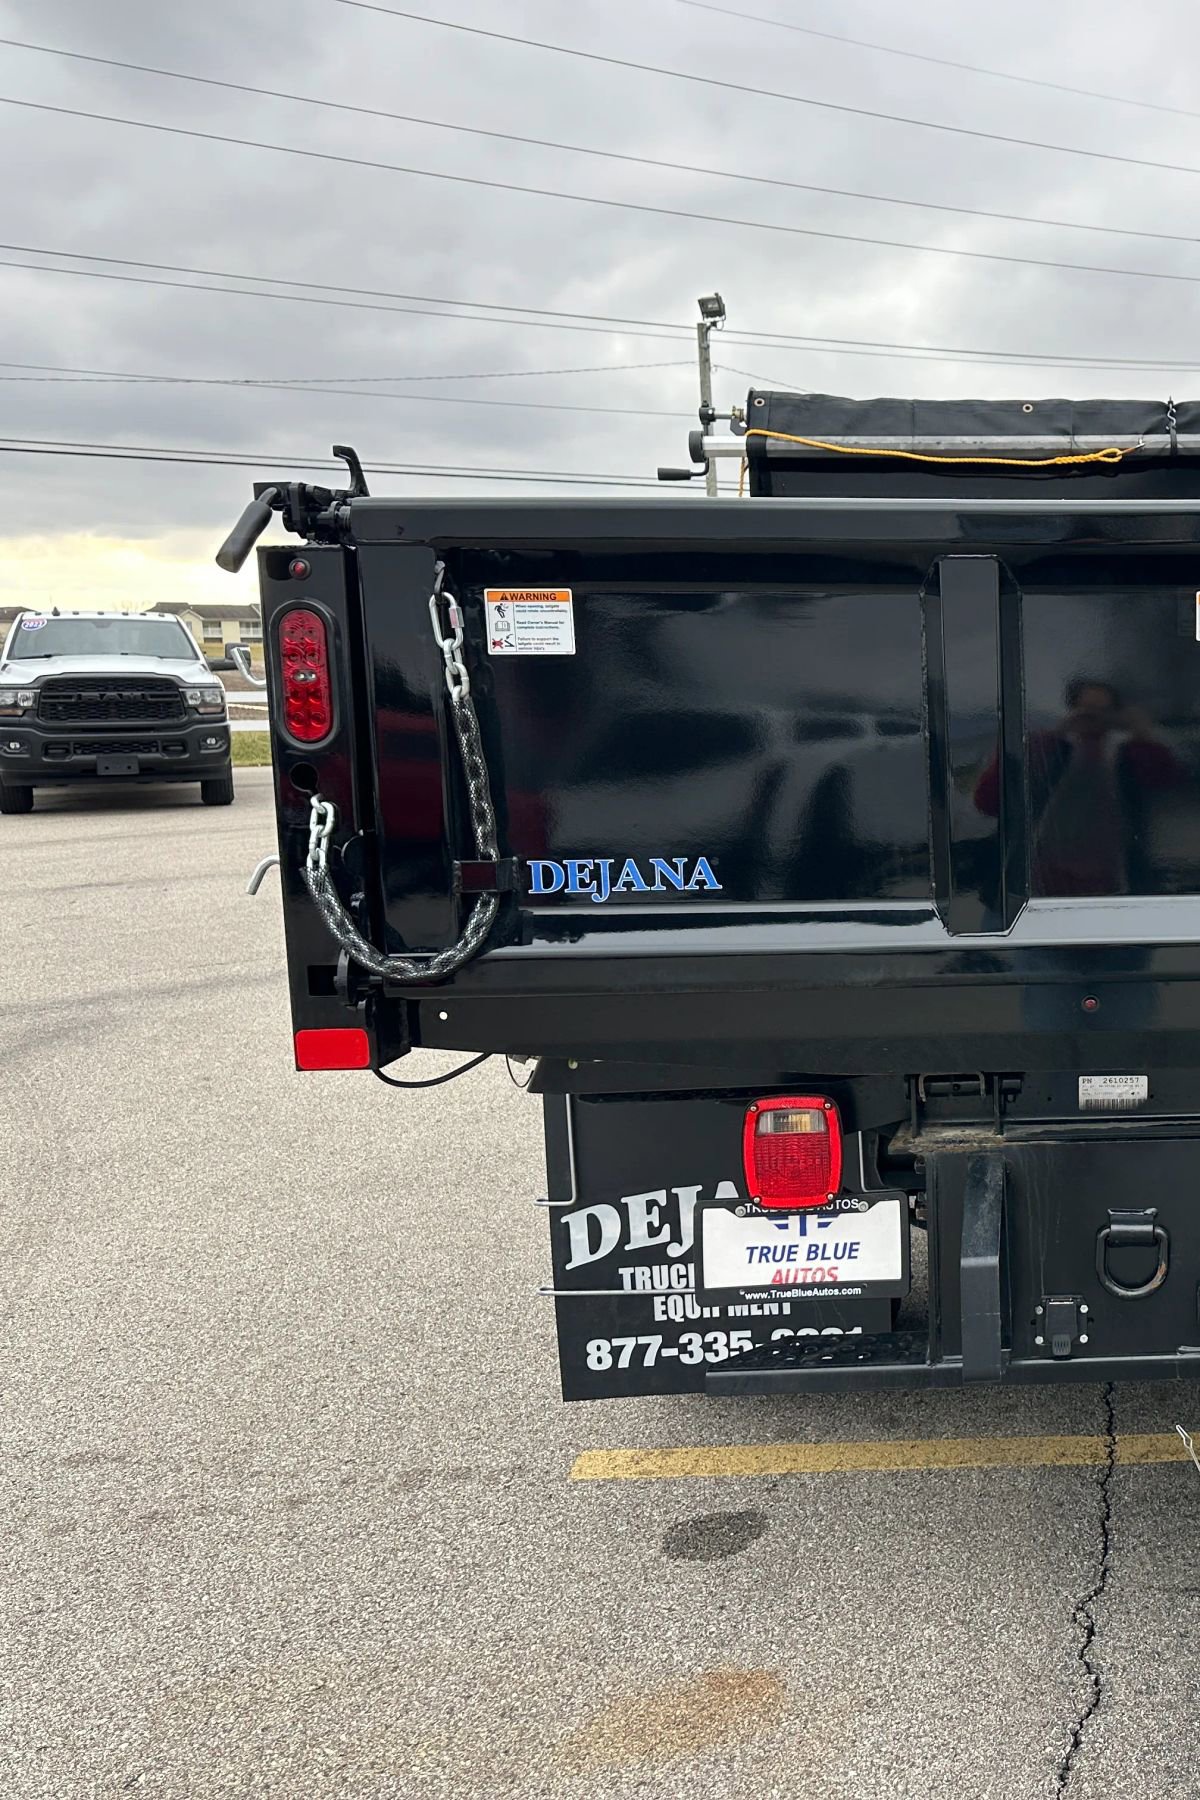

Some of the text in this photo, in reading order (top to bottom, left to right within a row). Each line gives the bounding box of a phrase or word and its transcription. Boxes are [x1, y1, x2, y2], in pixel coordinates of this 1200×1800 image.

[509, 592, 557, 601] WARNING
[526, 857, 723, 903] DEJANA
[746, 1241, 861, 1264] TRUE BLUE
[771, 1266, 839, 1285] AUTOS
[745, 1286, 862, 1300] www.TrueBlueAutos.com
